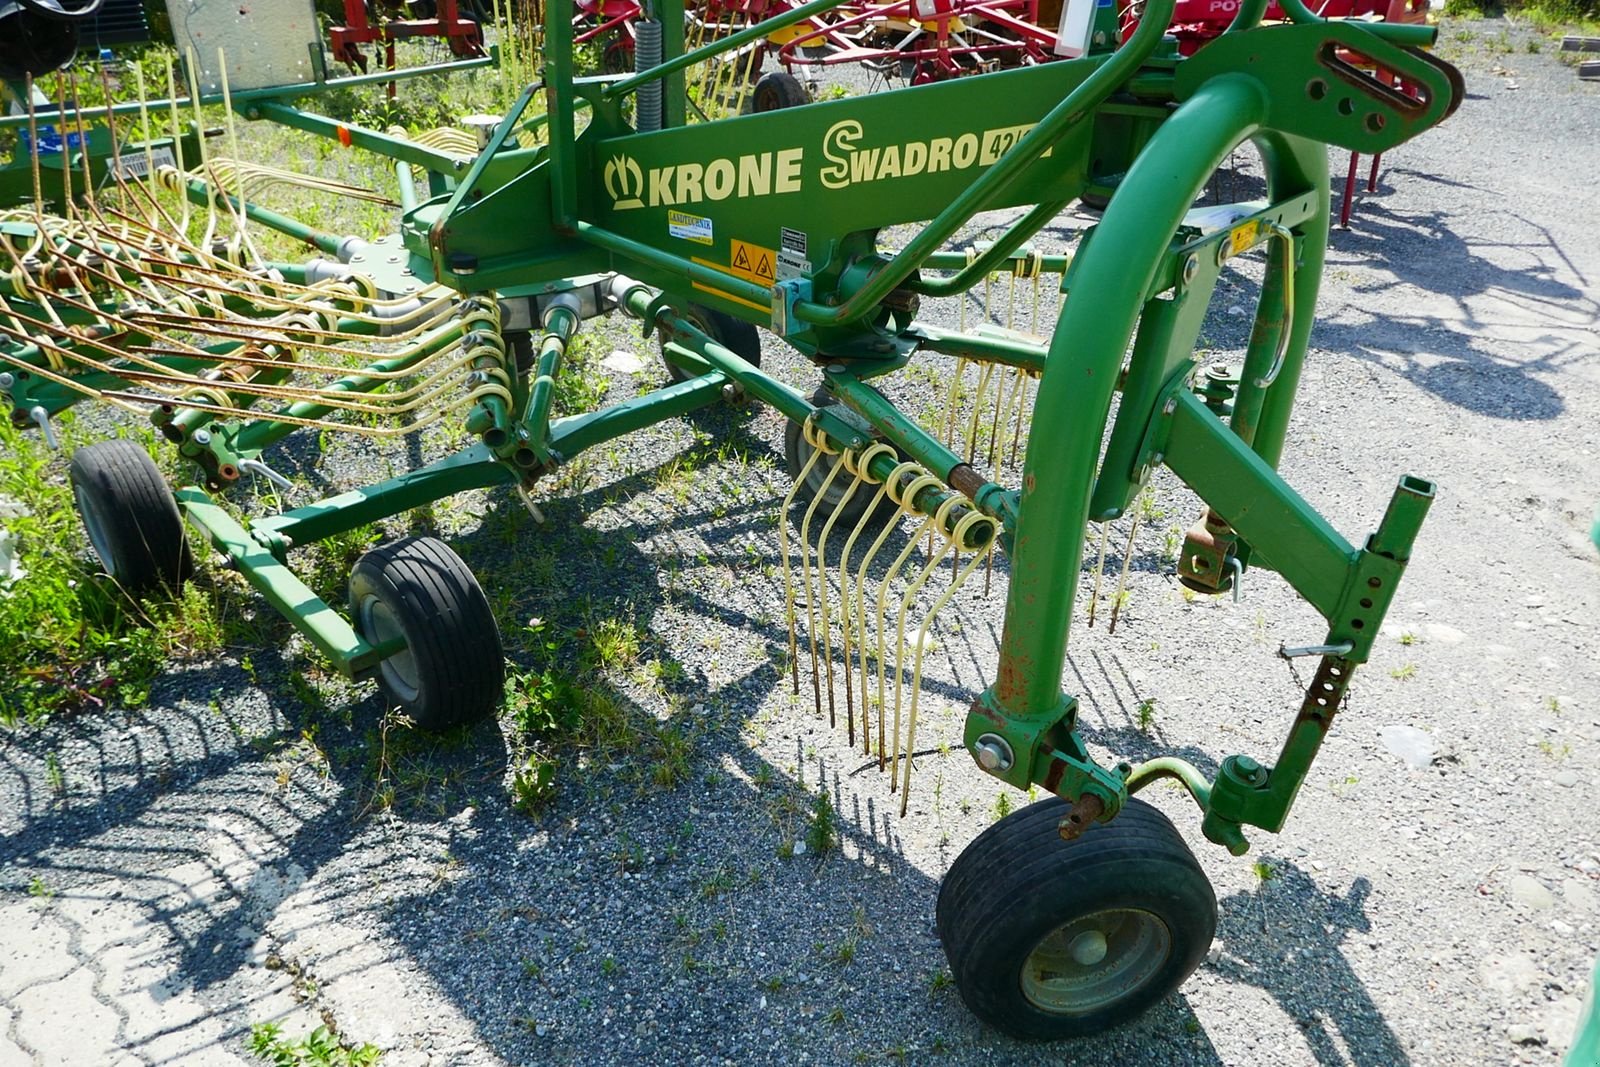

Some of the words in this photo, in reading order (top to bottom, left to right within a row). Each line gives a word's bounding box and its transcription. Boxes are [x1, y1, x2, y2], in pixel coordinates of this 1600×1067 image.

[649, 147, 804, 207] KRONE
[820, 119, 979, 190] SWADRO
[783, 258, 801, 269] KRONE
